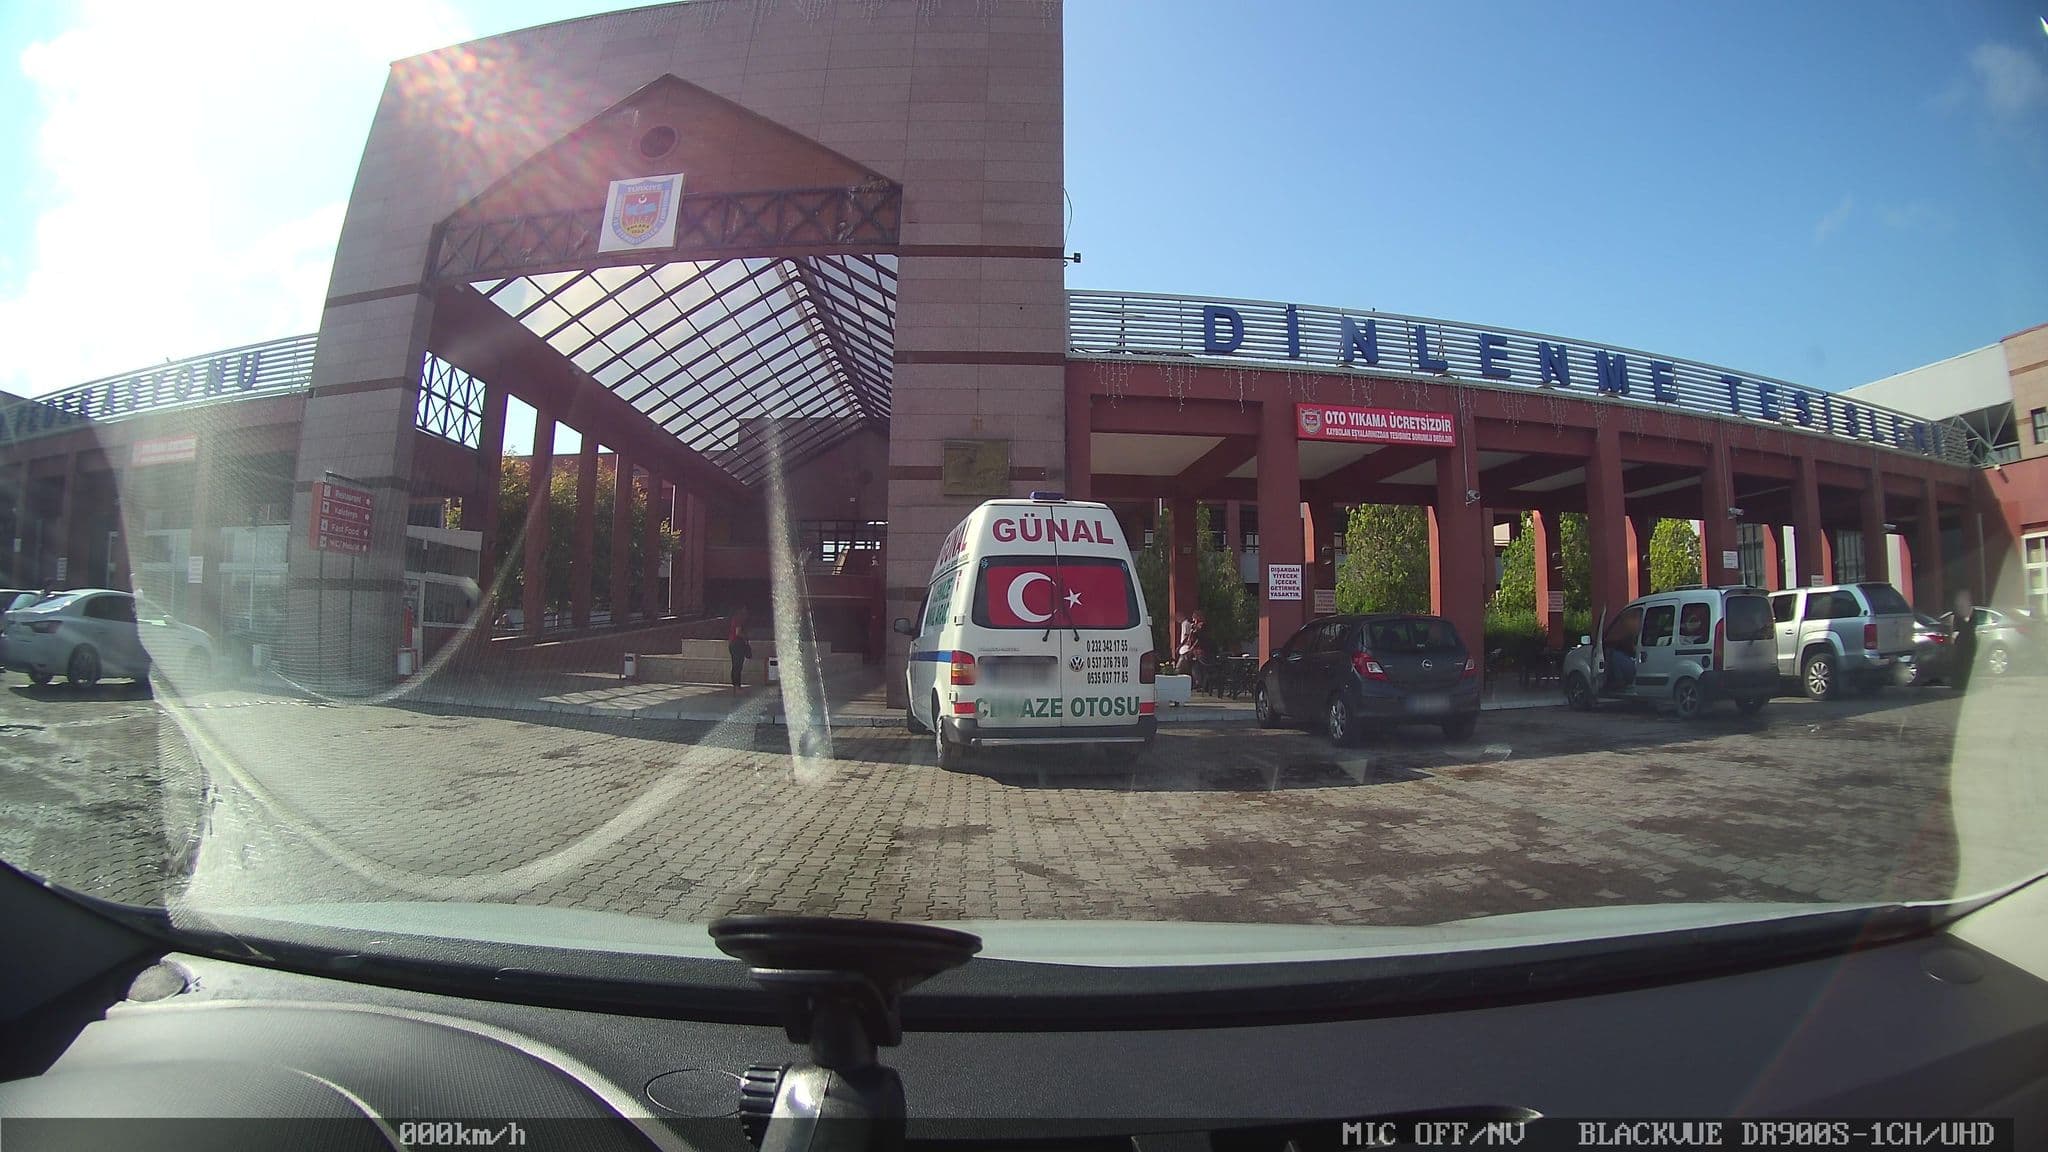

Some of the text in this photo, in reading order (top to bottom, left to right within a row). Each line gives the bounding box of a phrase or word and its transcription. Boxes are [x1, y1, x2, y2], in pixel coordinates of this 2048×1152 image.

[1203, 304, 1678, 401] DİNLENME
[1325, 410, 1452, 432] OTO YIKAMA ÜCRETSİZDİR
[992, 513, 1114, 545] GÜNAL
[1091, 640, 1102, 652] 232
[1102, 640, 1113, 652] 342
[1113, 640, 1120, 652] 17
[1121, 640, 1128, 652] 55
[1092, 657, 1102, 669] 537
[1103, 656, 1113, 668] 376
[1121, 656, 1129, 668] 00
[1087, 672, 1101, 684] 0535
[1102, 671, 1112, 684] 037
[1113, 671, 1120, 683] 77
[1070, 696, 1140, 717] OTOSU
